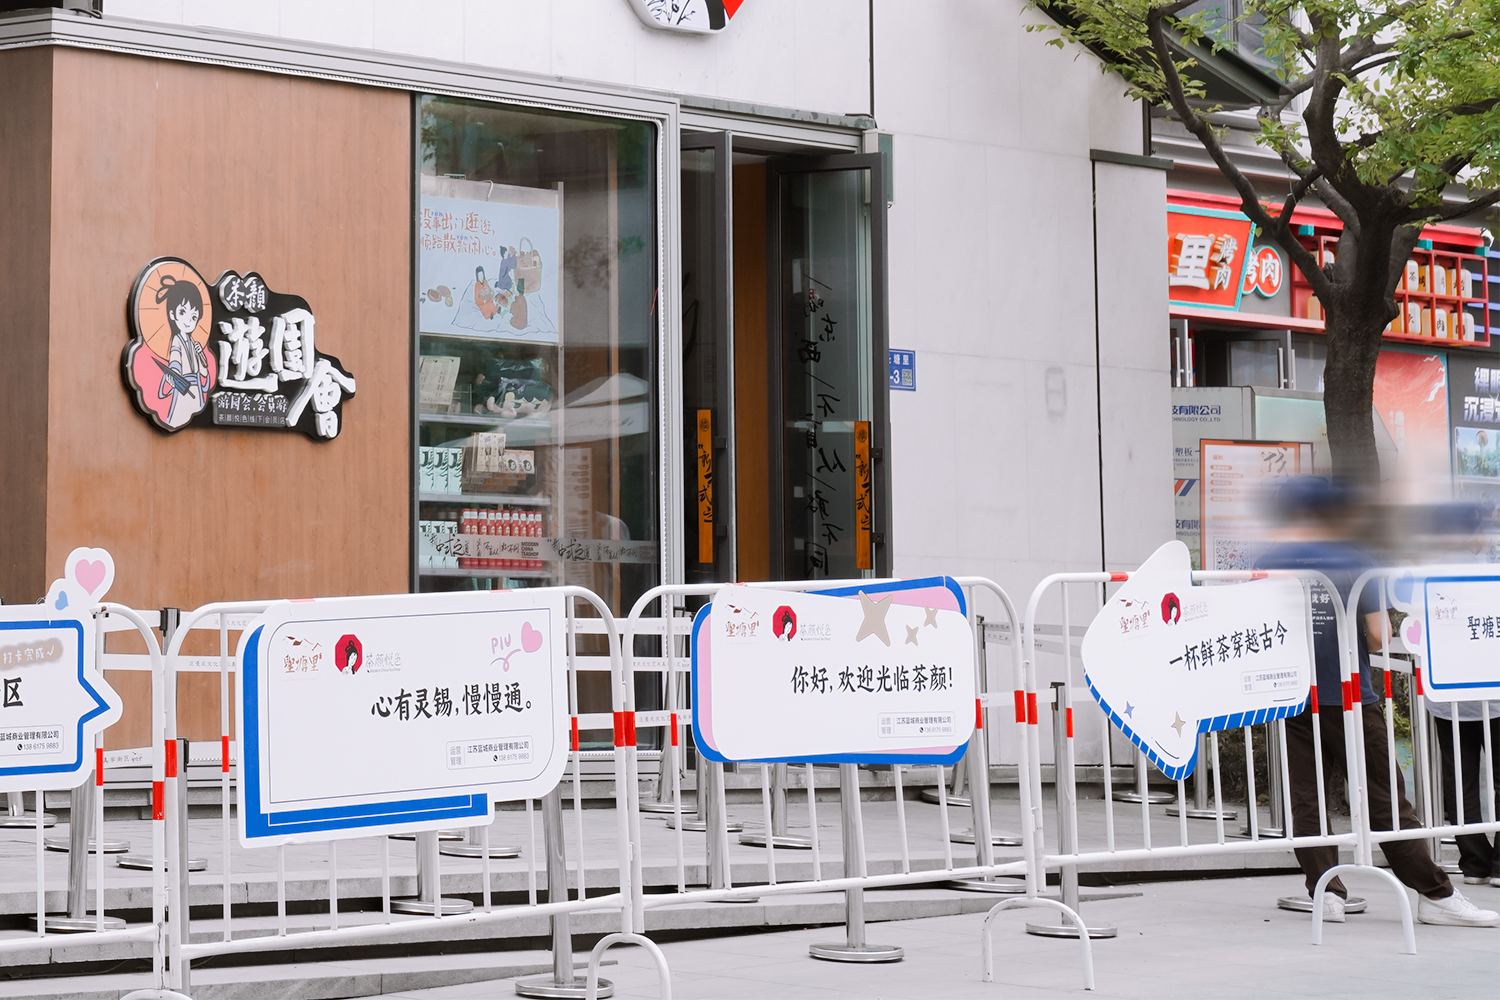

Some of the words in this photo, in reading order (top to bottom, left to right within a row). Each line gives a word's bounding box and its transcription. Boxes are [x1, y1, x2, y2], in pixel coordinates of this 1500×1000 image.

[890, 355, 910, 365] 塘里
[3, 645, 45, 665] 打卡完成
[1169, 620, 1288, 671] 一杯鲜茶穿越古今
[790, 663, 954, 695] 你好,欢迎光临茶颜!
[370, 681, 532, 721] 心有灵锡,慢慢通。
